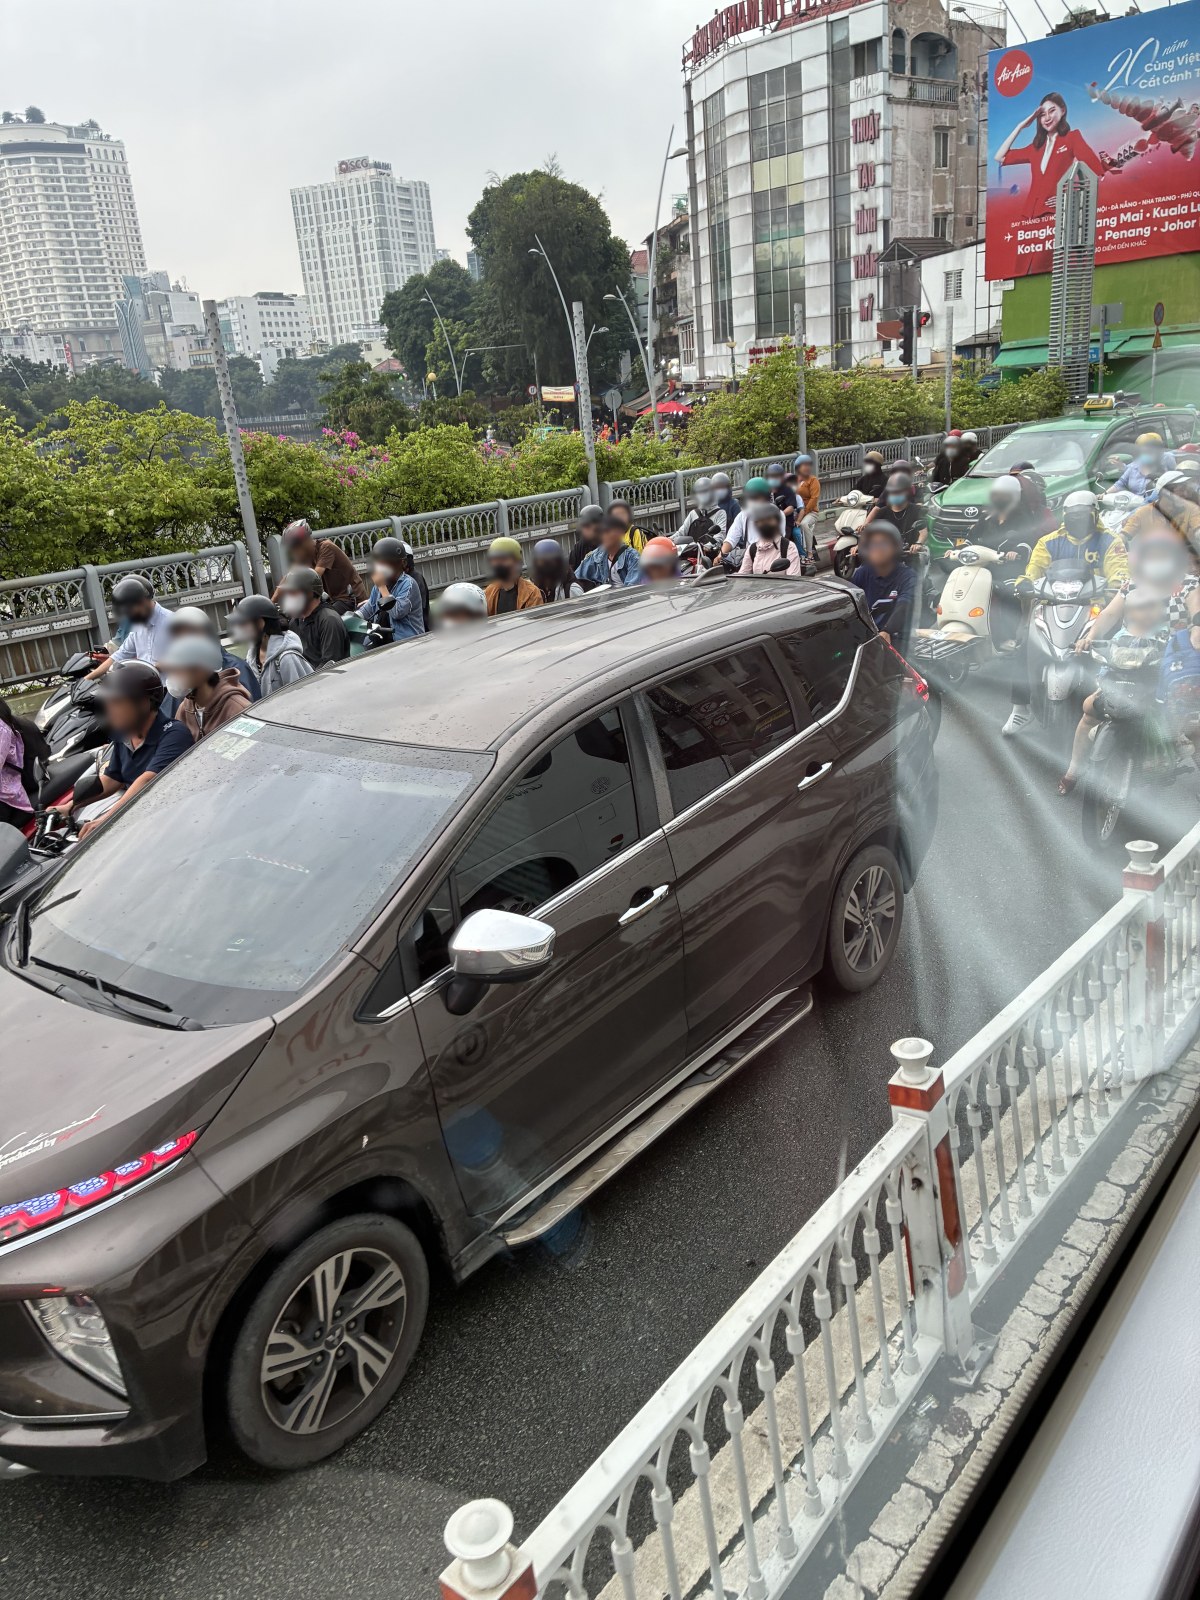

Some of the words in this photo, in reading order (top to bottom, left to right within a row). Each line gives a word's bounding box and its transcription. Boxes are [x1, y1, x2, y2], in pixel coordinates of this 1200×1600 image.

[1144, 59, 1175, 73] Cùng
[1177, 52, 1200, 66] Việt
[1162, 70, 1192, 85] Cánh
[1155, 194, 1177, 203] TRANG
[1095, 216, 1117, 228] ang
[1119, 209, 1144, 223] Mai
[1152, 203, 1188, 219] Kuala
[1017, 243, 1043, 255] Kota
[1105, 226, 1151, 241] Penang
[1160, 219, 1197, 233] Johor
